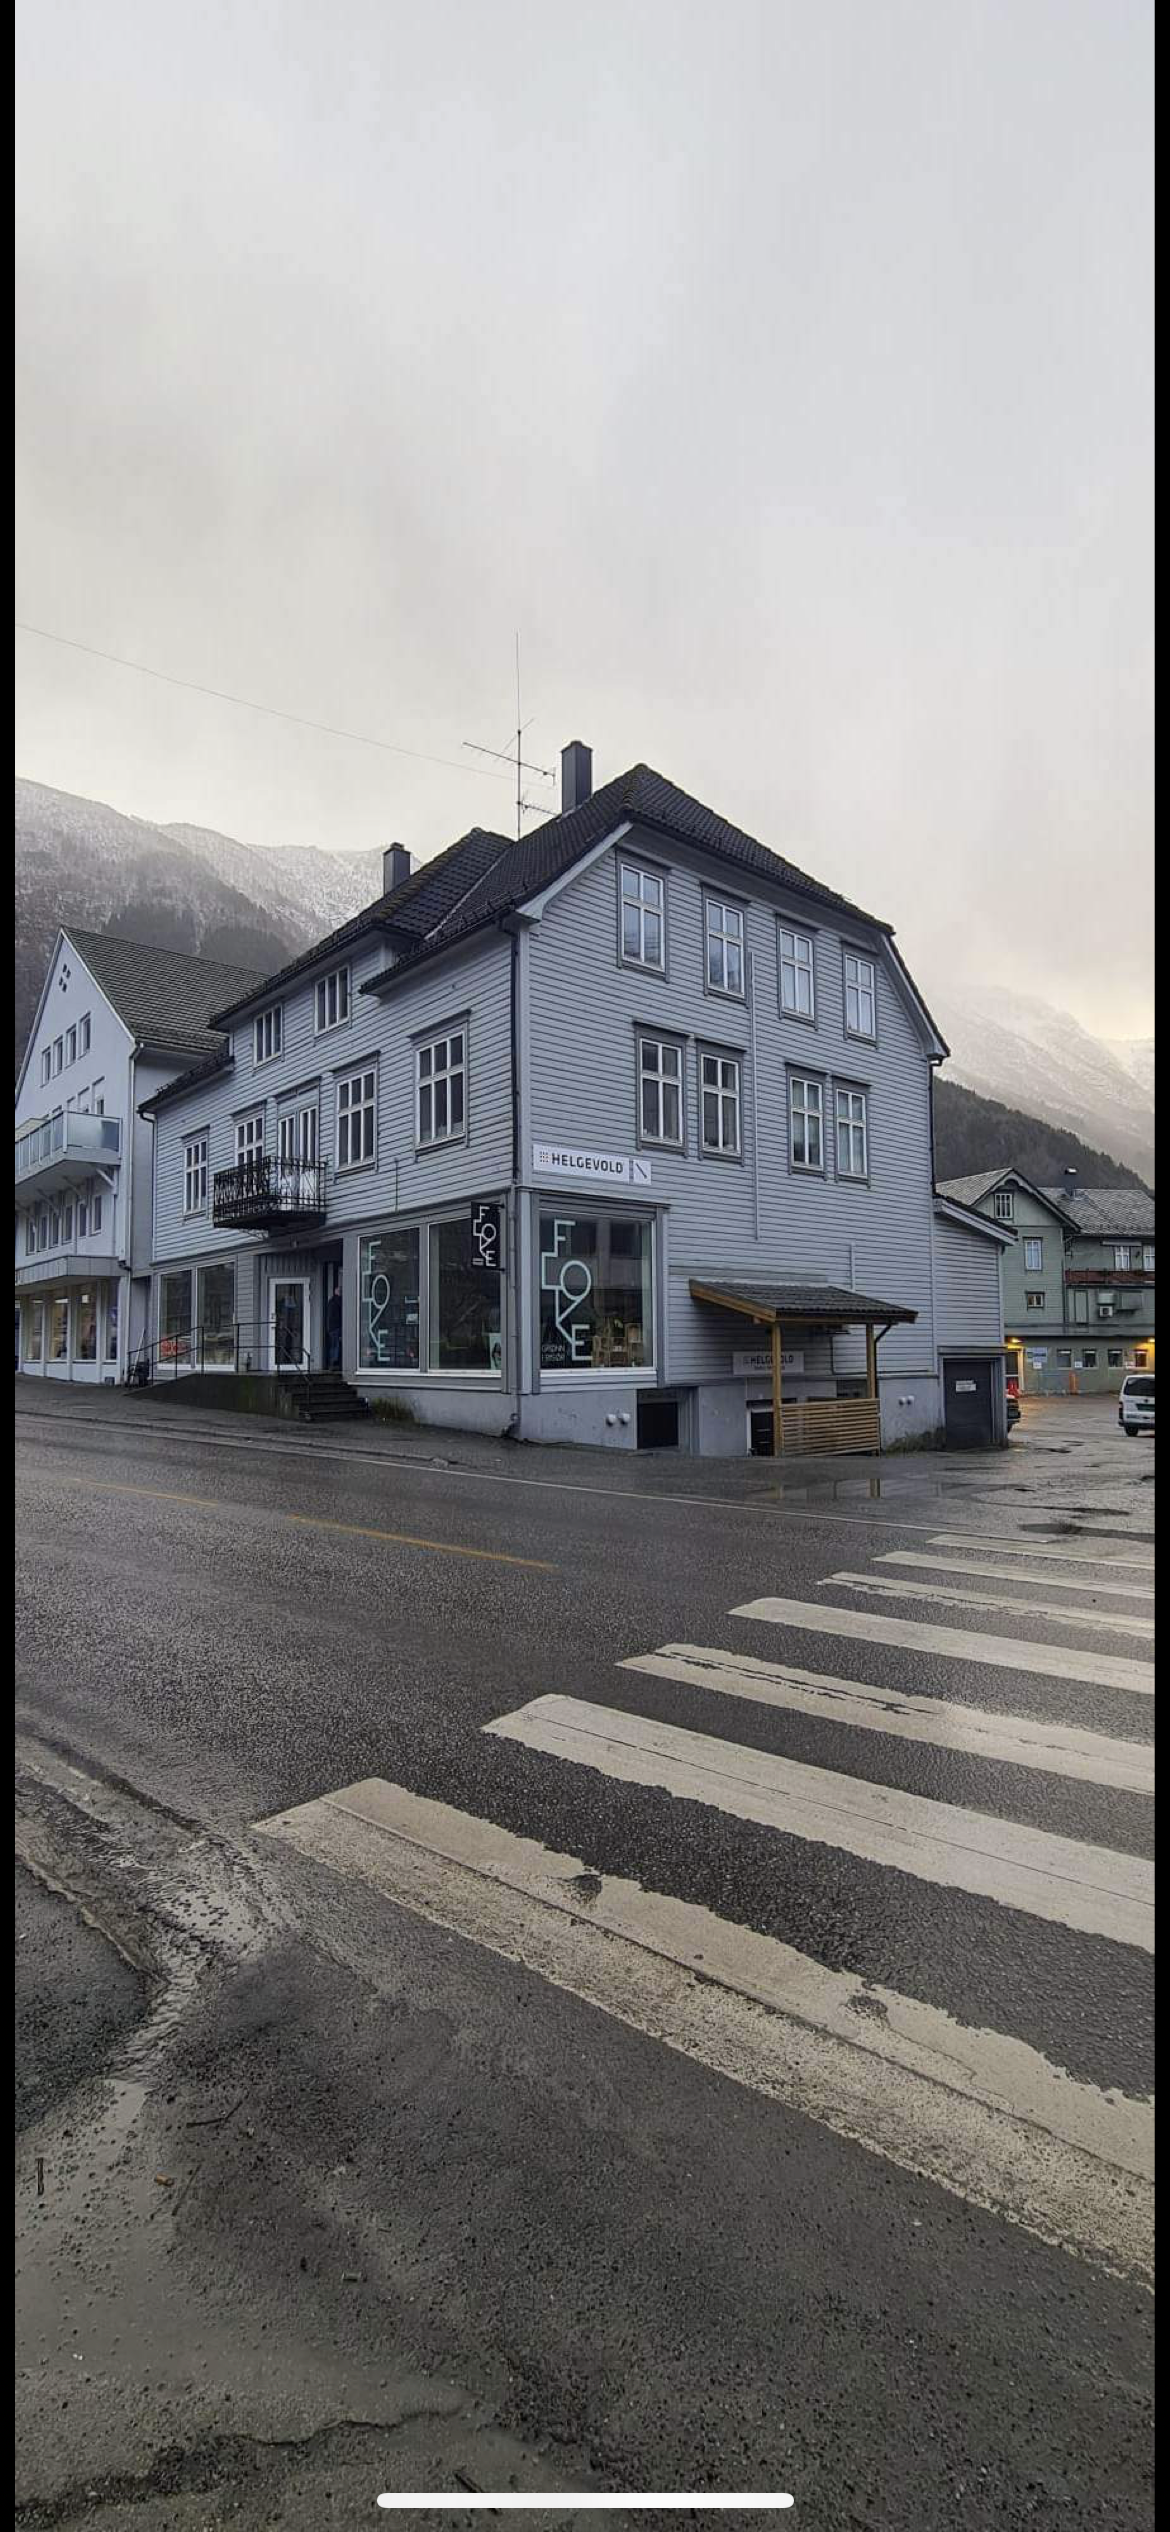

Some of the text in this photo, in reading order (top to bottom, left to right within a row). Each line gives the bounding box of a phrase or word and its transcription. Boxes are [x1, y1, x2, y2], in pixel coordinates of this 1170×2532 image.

[551, 1153, 623, 1174] HELGEVOLD
[473, 1205, 497, 1267] FLOKE
[361, 1240, 391, 1362] FLOKE
[541, 1219, 593, 1361] FLOKE
